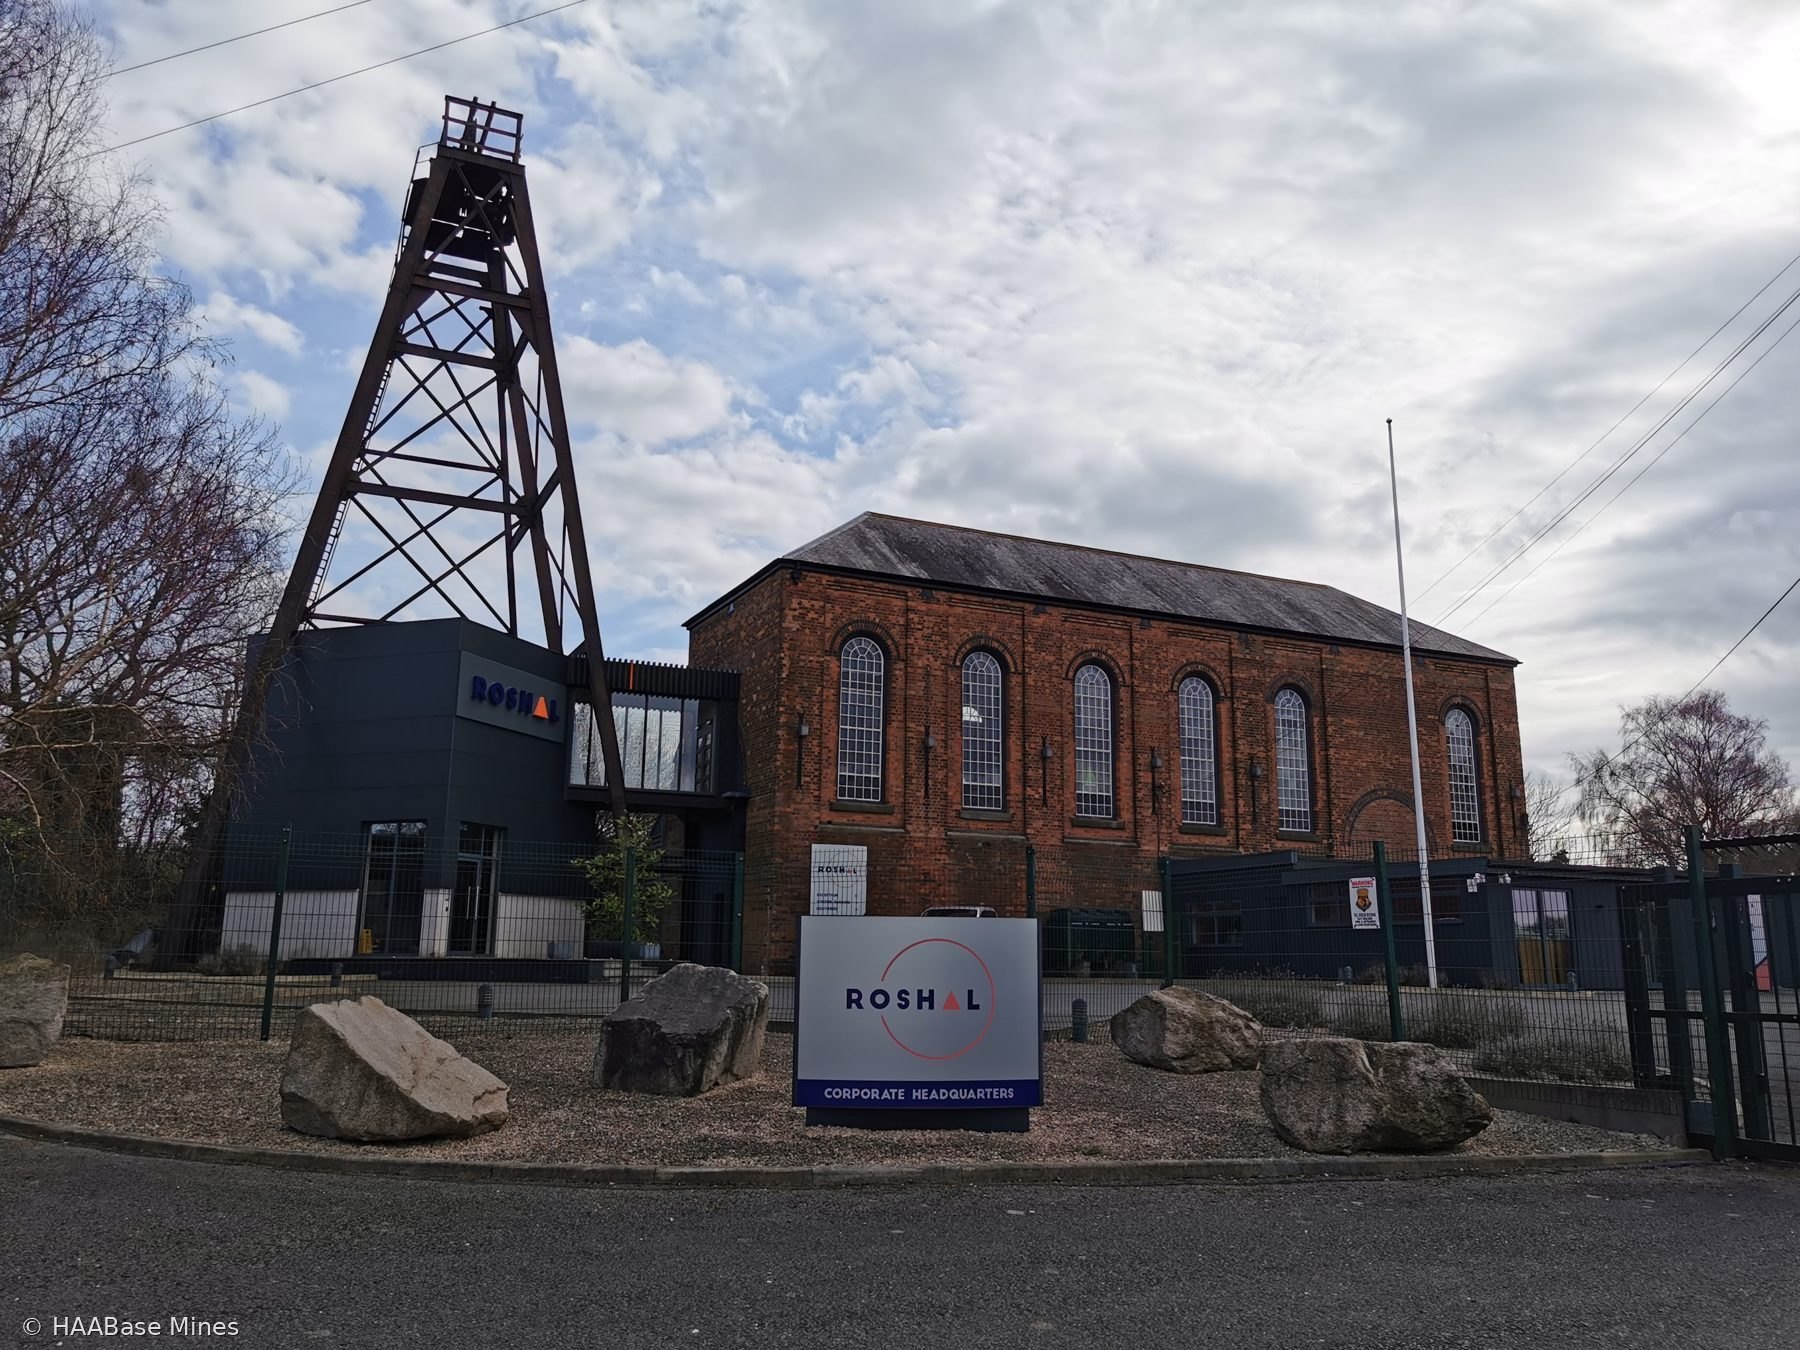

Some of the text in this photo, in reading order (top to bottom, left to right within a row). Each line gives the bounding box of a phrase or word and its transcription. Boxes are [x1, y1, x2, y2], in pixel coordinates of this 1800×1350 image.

[472, 675, 560, 722] ROSHAL
[846, 988, 980, 1010] ROSHAL
[824, 1087, 1014, 1100] CORPORATE HEADQUARTERS
